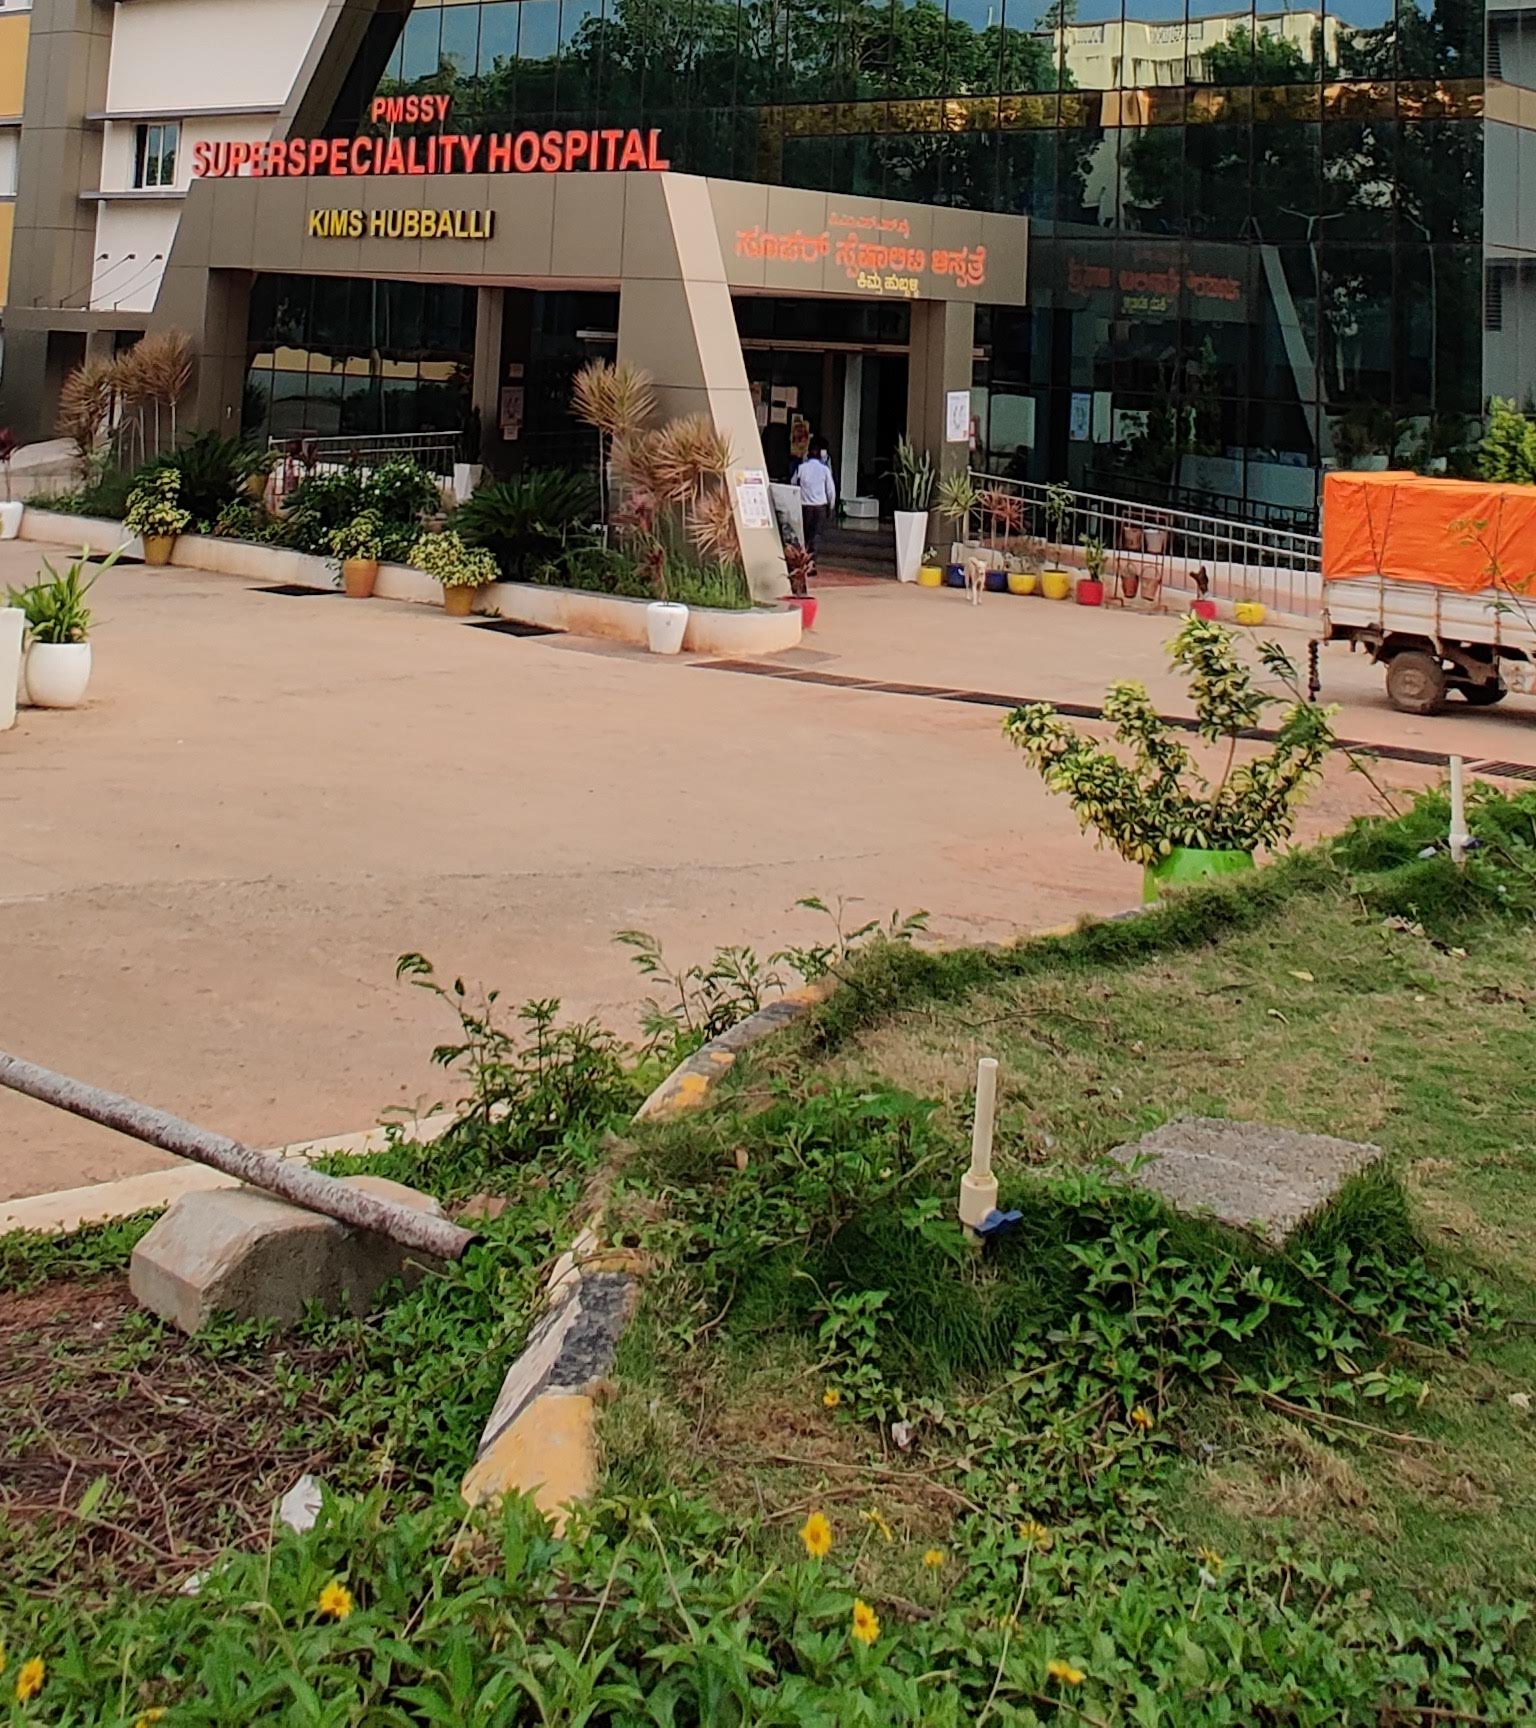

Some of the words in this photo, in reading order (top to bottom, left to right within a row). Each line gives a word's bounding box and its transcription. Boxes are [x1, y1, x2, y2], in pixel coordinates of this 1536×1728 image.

[371, 95, 451, 125] PMSSY
[192, 134, 481, 177] SUPERSPECIALITY
[488, 128, 670, 173] HOSPITAL
[308, 209, 364, 238] KIMS
[370, 209, 495, 238] HUBBALLI
